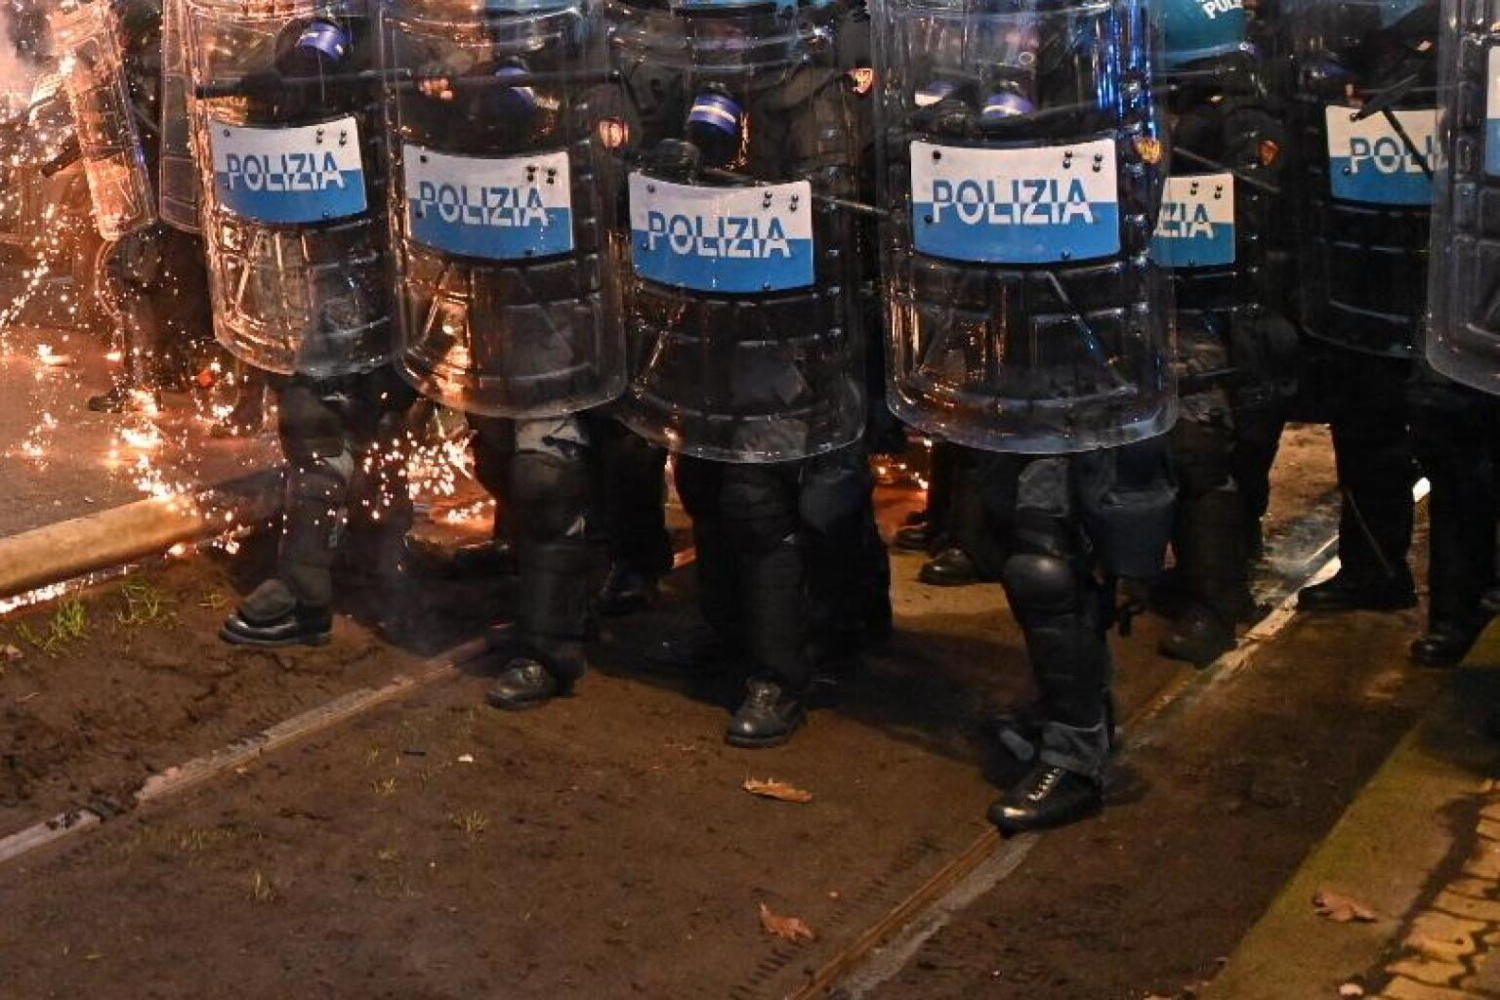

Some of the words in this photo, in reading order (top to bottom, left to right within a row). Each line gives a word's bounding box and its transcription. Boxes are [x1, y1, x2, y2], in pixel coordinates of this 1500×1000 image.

[226, 152, 346, 191] POLIZIA
[419, 181, 549, 227] POLIZIA
[933, 179, 1094, 225] POLIZIA
[648, 210, 792, 258] POLIZIA
